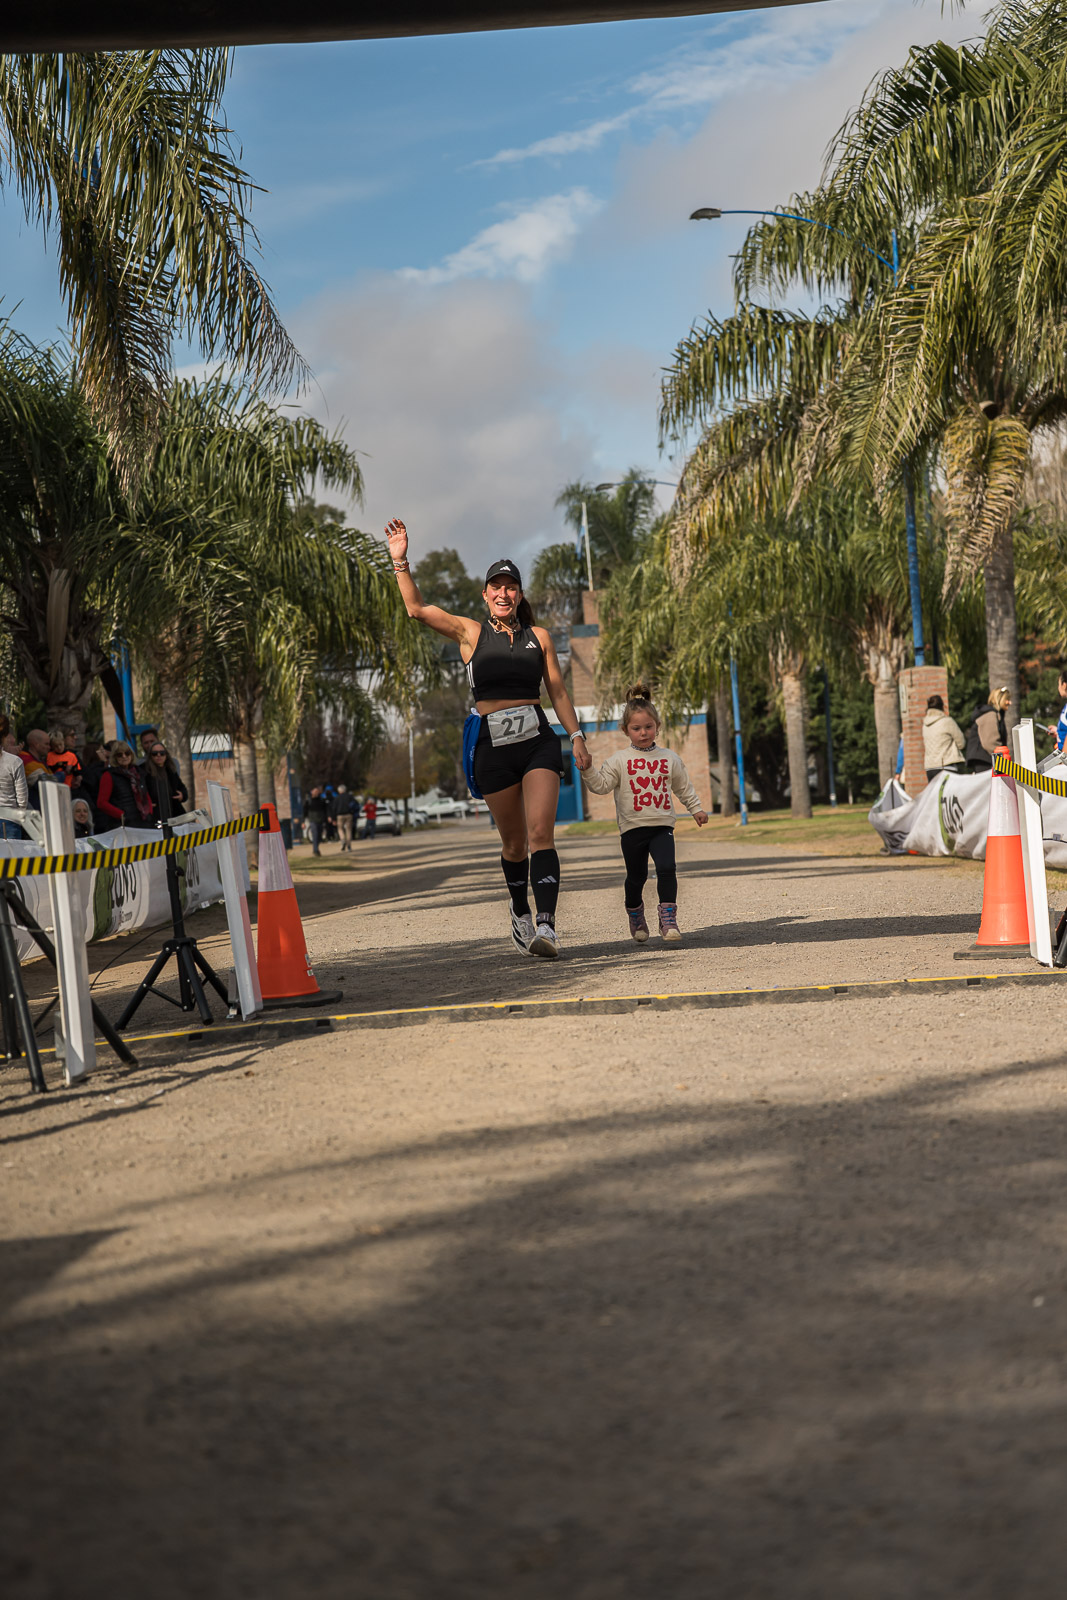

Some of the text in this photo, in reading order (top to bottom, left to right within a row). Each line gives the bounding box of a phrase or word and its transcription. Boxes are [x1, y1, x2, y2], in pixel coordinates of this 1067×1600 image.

[501, 715, 525, 736] 27
[627, 758, 669, 775] LOVE
[633, 792, 671, 811] LOVE
